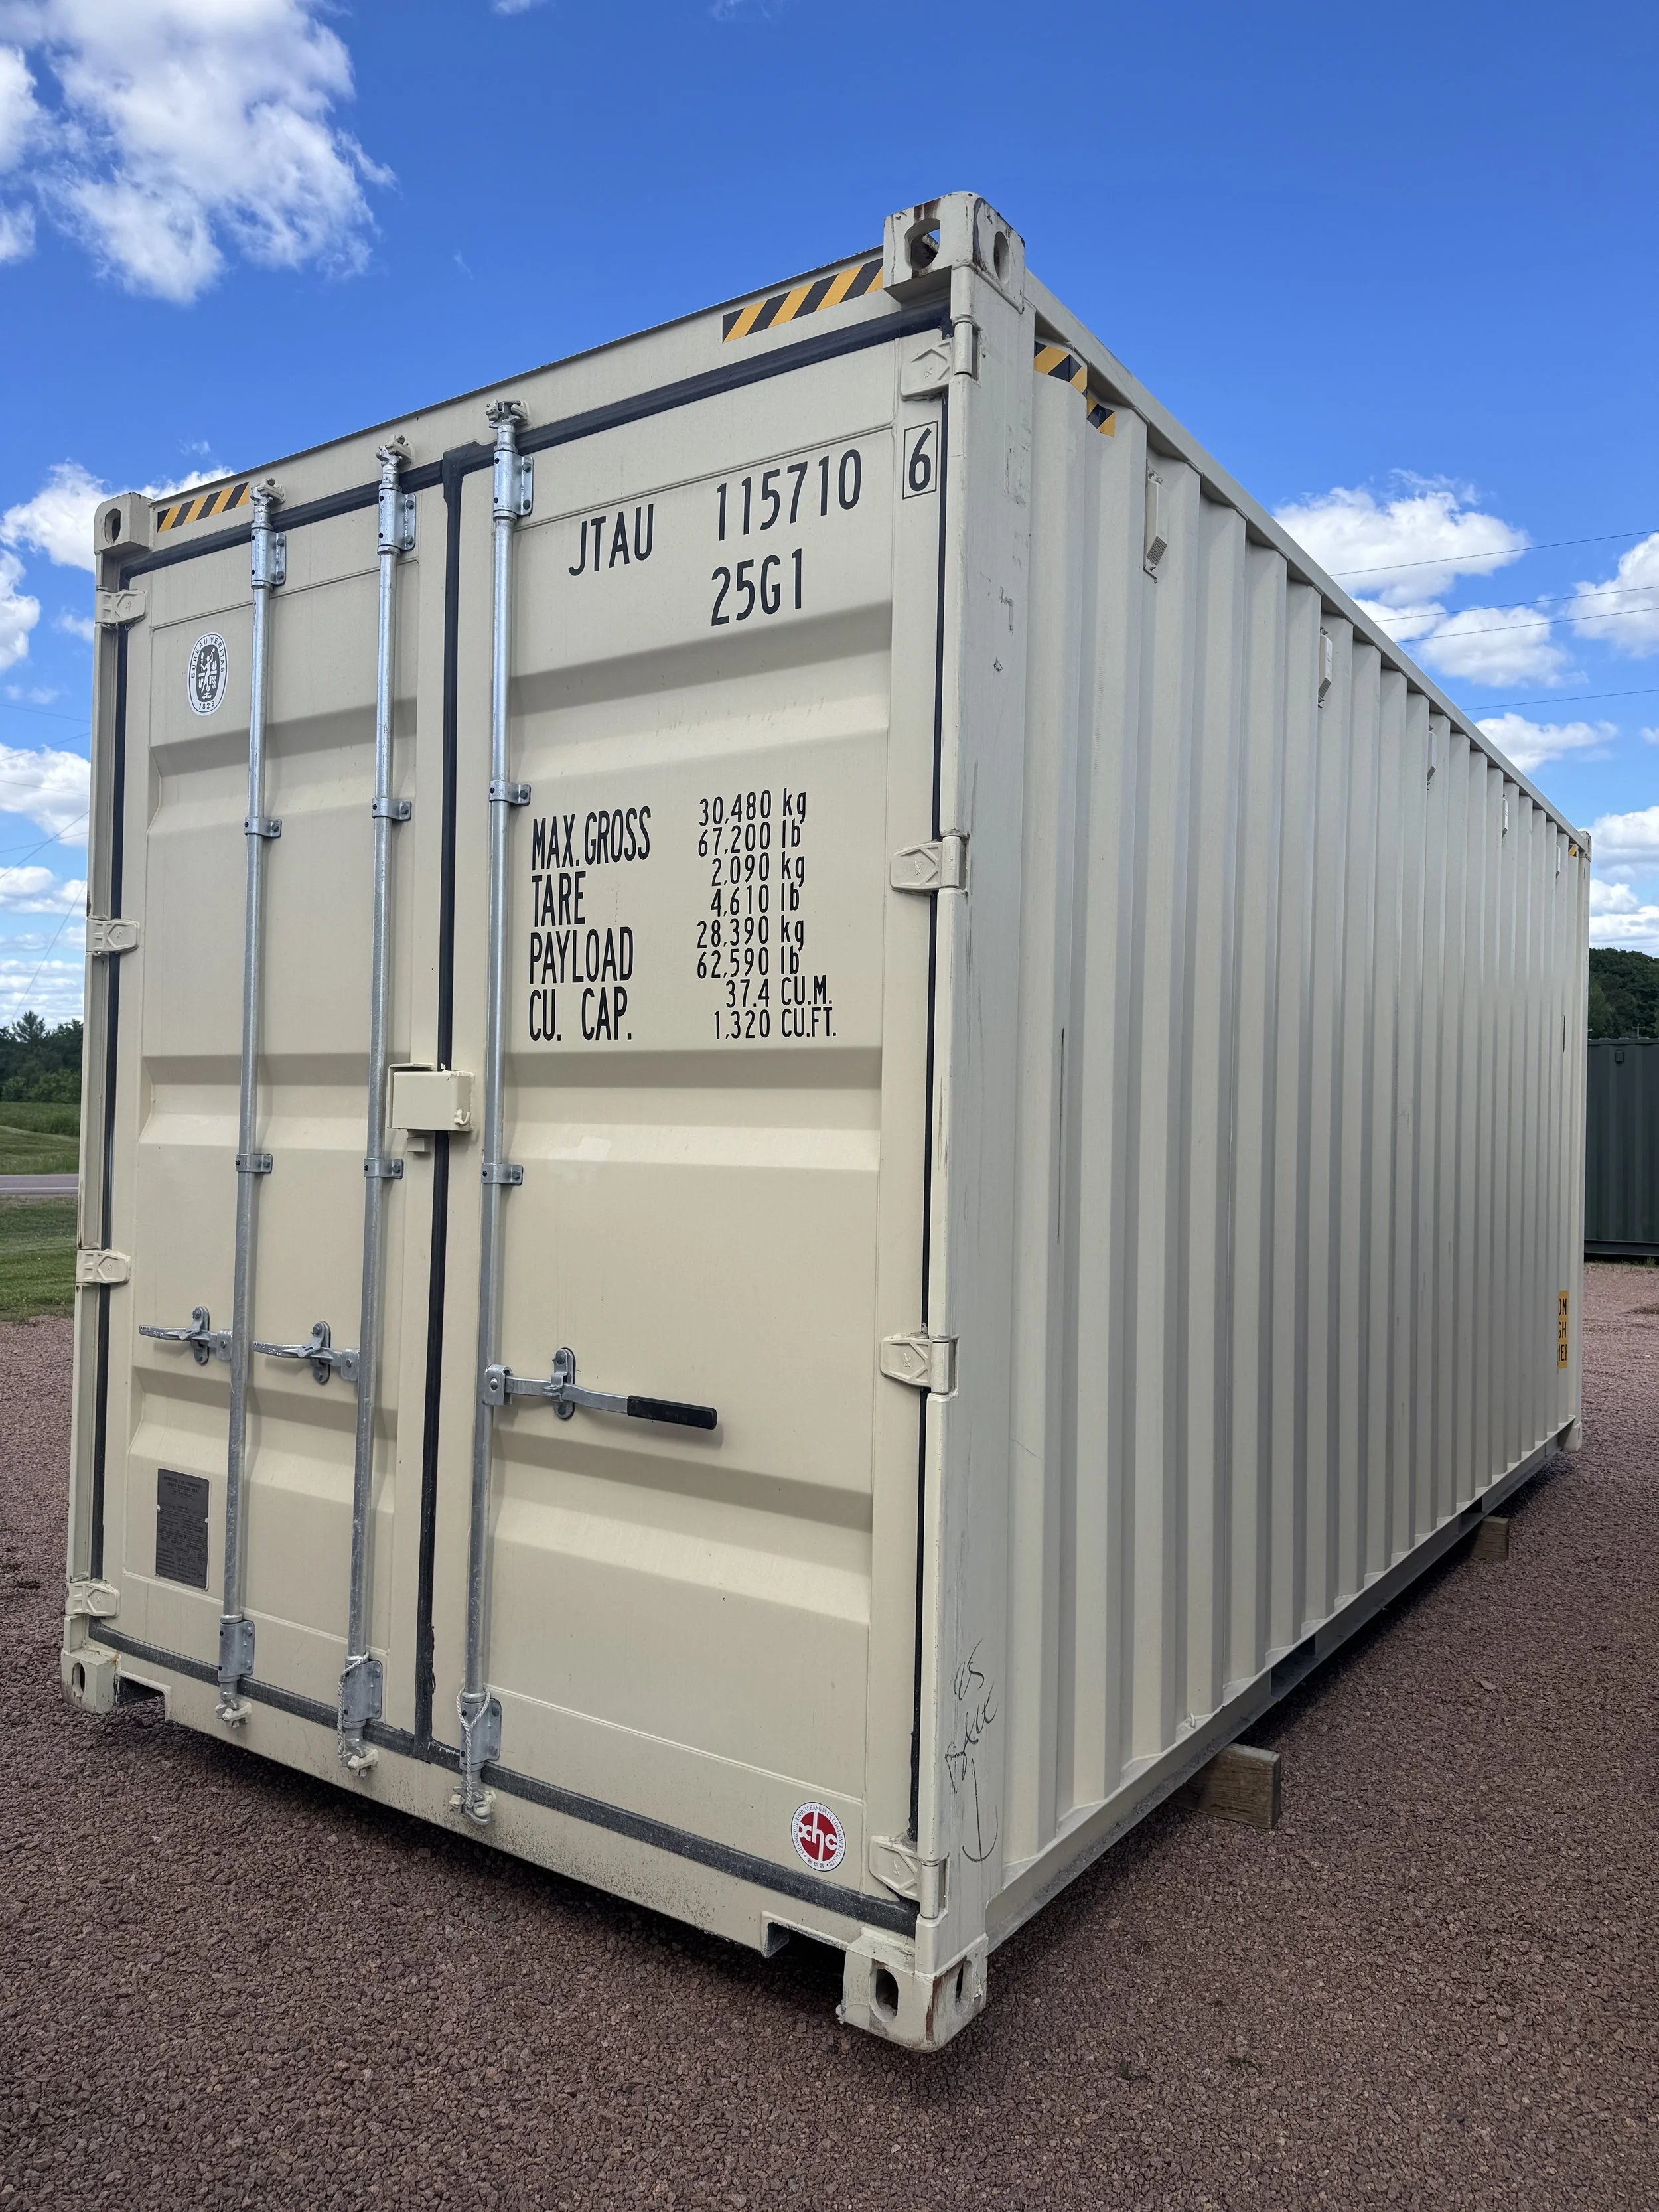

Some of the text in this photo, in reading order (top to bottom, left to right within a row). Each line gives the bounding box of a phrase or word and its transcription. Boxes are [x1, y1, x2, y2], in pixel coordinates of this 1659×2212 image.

[566, 425, 934, 577] JTAU 115710 6
[711, 548, 802, 627] 25G1
[191, 636, 225, 678] BUREAU VERITAS
[198, 700, 215, 710] 1828
[699, 787, 806, 827] 30,480 kg
[698, 818, 801, 857] 67,200 lb
[711, 850, 805, 888] 2,090 kg
[531, 871, 587, 928] TARE
[710, 881, 800, 917] 4,610 lb
[697, 914, 804, 952] 28,390 kg
[530, 926, 634, 985] PAYLOAD
[697, 944, 800, 979] 62,590 lb
[725, 978, 770, 1008] 37.4
[529, 986, 632, 1041] CU. CAP.
[714, 1009, 770, 1040] 1,320
